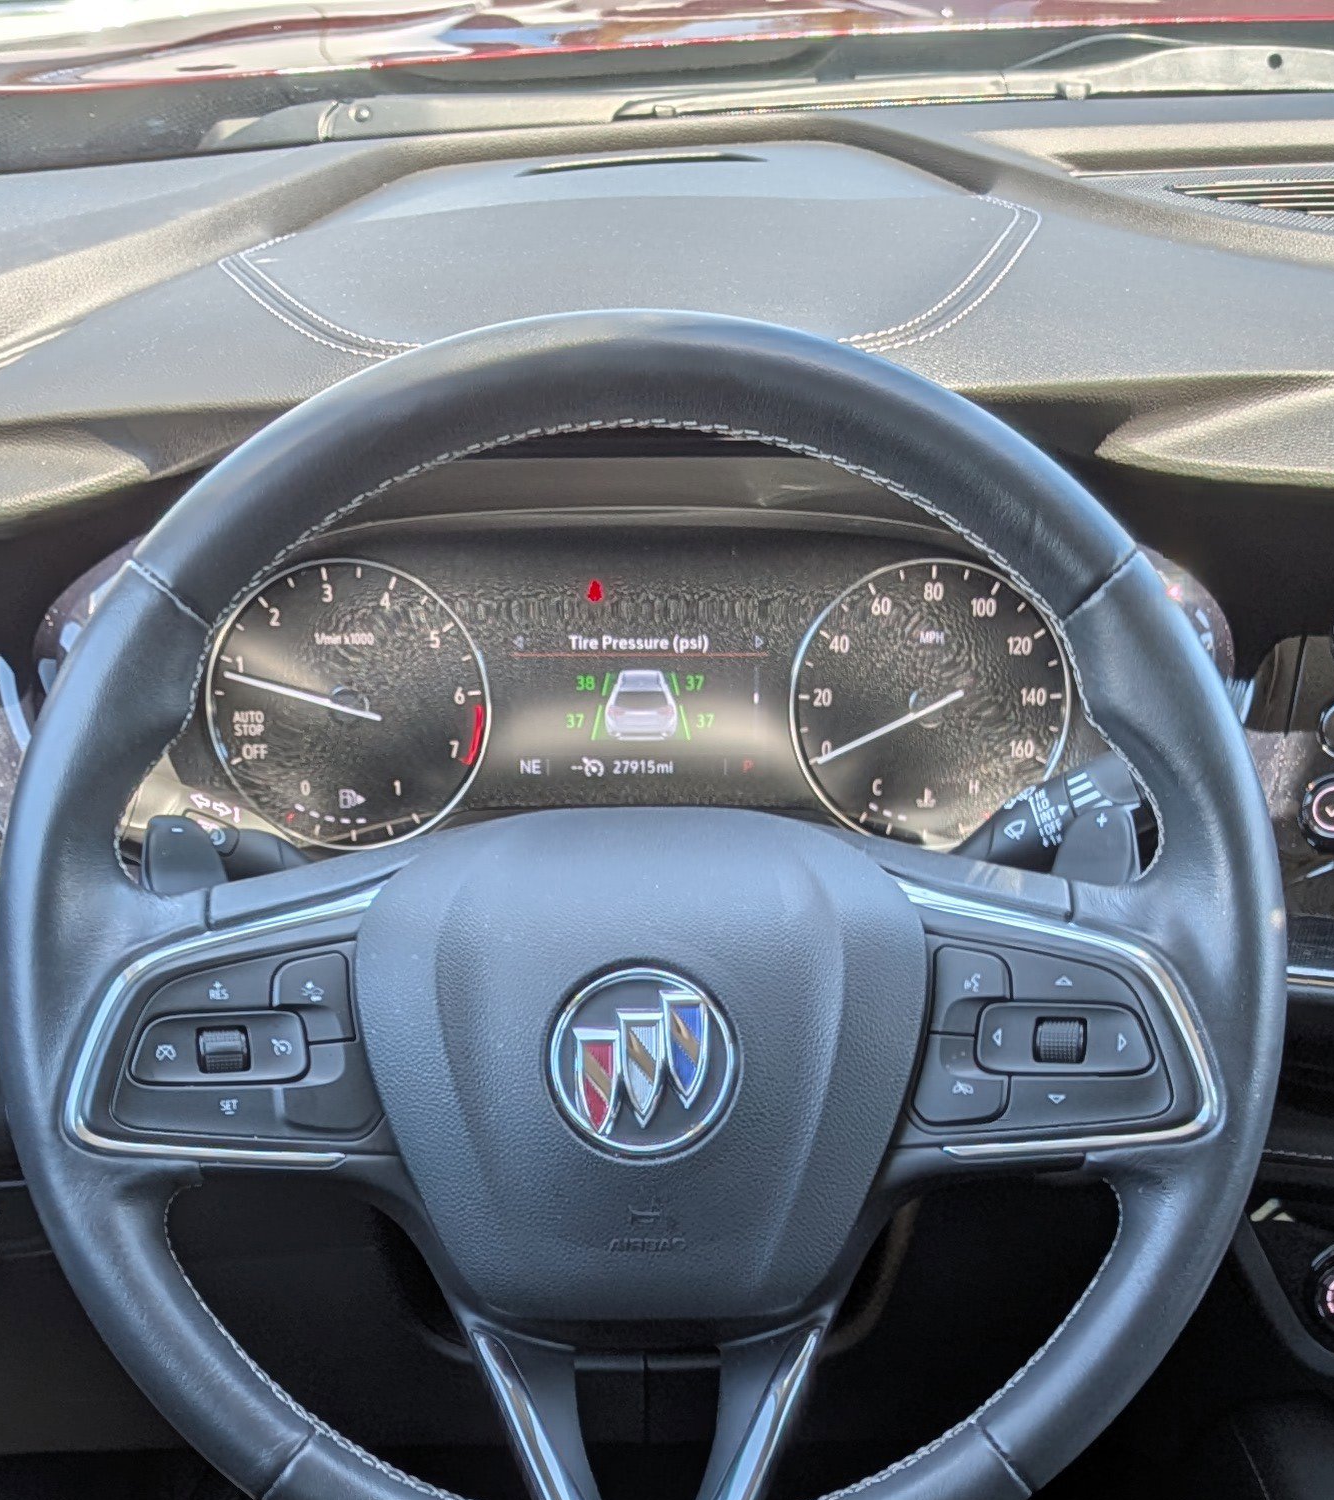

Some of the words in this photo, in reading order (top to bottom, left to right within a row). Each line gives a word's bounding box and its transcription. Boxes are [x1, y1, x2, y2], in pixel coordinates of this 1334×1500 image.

[321, 584, 333, 602] 3
[923, 582, 944, 601] 80
[380, 592, 390, 609] 4
[871, 597, 892, 615] 60
[970, 598, 997, 617] 100
[269, 607, 281, 626] 2
[429, 630, 440, 648] 5
[569, 634, 600, 650] Tire
[602, 634, 669, 650] Pressure
[672, 634, 709, 654] (psi)
[829, 635, 850, 653] 40
[919, 631, 945, 645] MPH
[1007, 636, 1032, 656] 120
[236, 655, 244, 673] 1
[576, 676, 595, 691] 38
[685, 676, 705, 691] 37
[454, 687, 465, 704] 6
[813, 688, 832, 707] 20
[1020, 688, 1046, 707] 140
[232, 711, 264, 724] AUTO
[566, 713, 585, 729] 37
[696, 713, 715, 728] 37
[234, 724, 264, 737] STOP
[242, 744, 267, 759] OFF
[449, 740, 459, 758] 7
[821, 740, 832, 757] 0
[1009, 740, 1034, 758] 160
[519, 760, 542, 775] NE
[300, 780, 310, 796] 0
[393, 780, 401, 796] 1
[872, 779, 883, 797] C
[968, 780, 979, 793] H
[219, 1098, 239, 1112] SET
